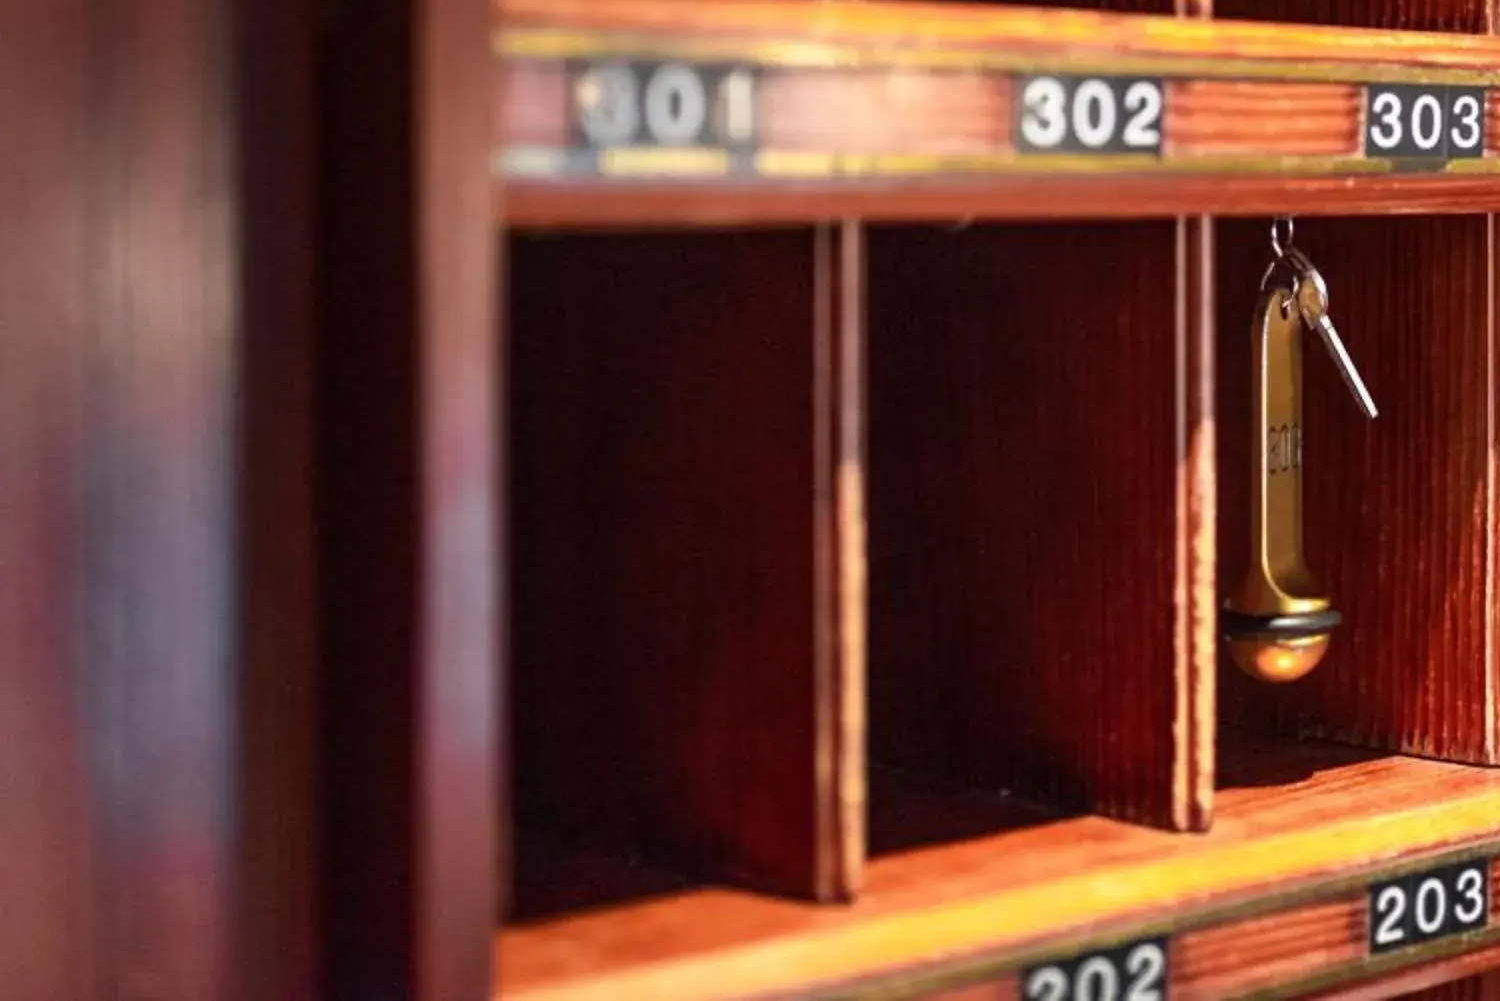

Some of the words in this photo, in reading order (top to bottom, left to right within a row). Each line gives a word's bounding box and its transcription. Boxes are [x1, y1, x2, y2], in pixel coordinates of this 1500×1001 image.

[1021, 77, 1162, 146] 302
[1370, 93, 1480, 149] 303
[1375, 868, 1484, 945] 203
